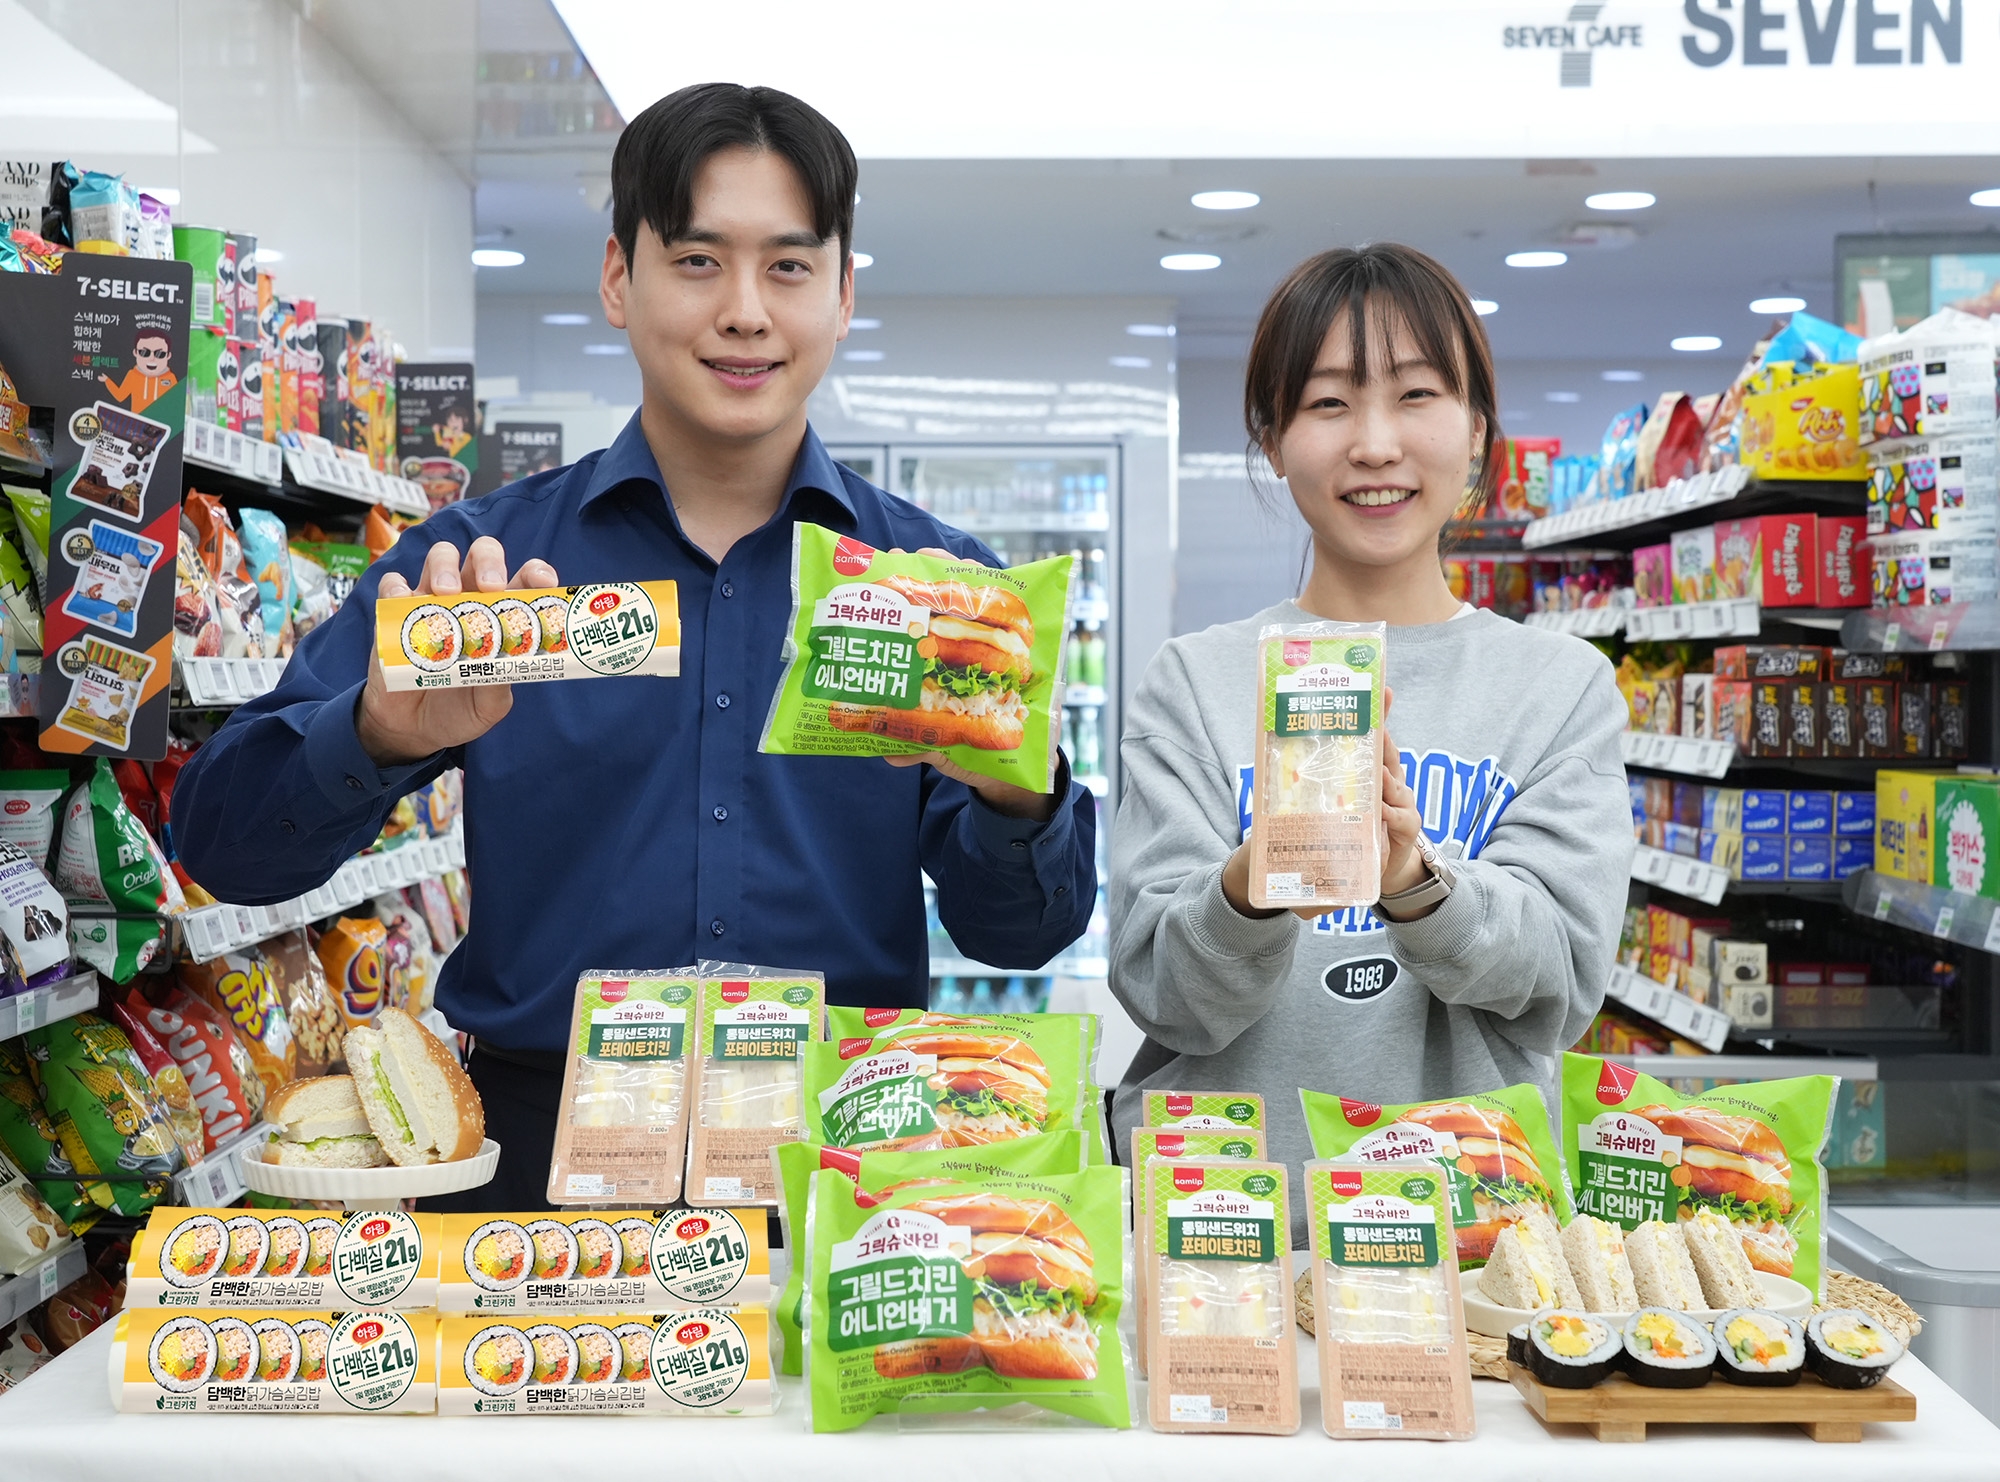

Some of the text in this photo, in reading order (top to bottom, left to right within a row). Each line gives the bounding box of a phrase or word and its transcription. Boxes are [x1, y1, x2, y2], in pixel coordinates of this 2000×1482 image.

[1503, 25, 1642, 48] SEVEN CAFE
[1682, 0, 1963, 67] SEVEN
[4, 174, 39, 188] chips
[77, 276, 179, 303] 7-SELECT
[74, 312, 120, 326] 스낵 MD가
[74, 326, 102, 339] 힙하게
[73, 341, 101, 353] 개발한
[73, 355, 119, 368] 세븐셀렉트
[71, 369, 94, 381] 스낵!
[400, 375, 468, 391] 7-SELECT
[84, 417, 90, 427] 4
[77, 538, 83, 548] 5
[835, 554, 871, 567] samlip
[572, 585, 598, 615] PROTEIN
[594, 595, 616, 611] 하림
[828, 604, 902, 626] 그릭슈바인
[572, 607, 655, 657] 단백질 21g
[72, 651, 78, 661] 6
[818, 635, 913, 669] 그릴드치킨
[424, 677, 452, 687] 그린키친
[814, 662, 908, 698] 어니언버거
[1298, 677, 1350, 688] 그릭슈바인
[819, 703, 843, 712] Chicken
[845, 707, 864, 716] Onion
[866, 710, 888, 718] Burger
[1288, 696, 1358, 711] 통밀샌드위치
[1286, 712, 1358, 731] 포테이토치킨
[1952, 831, 1980, 865] 박카스
[0, 864, 27, 881] HOCOLATE
[1344, 964, 1385, 993] 1983
[601, 990, 627, 998] samlip
[722, 990, 748, 998] samlip
[613, 1011, 664, 1021] 그릭슈바인
[736, 1011, 788, 1021] 그릭슈바인
[866, 1010, 900, 1021] samlip
[602, 1028, 670, 1040] 통밀샌드위치
[726, 1028, 796, 1040] 통밀샌드위치
[598, 1041, 670, 1057] 포테이토치킨
[724, 1040, 796, 1056] 포테이토치킨
[840, 1038, 872, 1055] samlip
[838, 1062, 910, 1095] 그릭슈바인
[1598, 1084, 1628, 1097] samlip
[1346, 1104, 1382, 1118] samlip
[1596, 1131, 1656, 1156] 그릭슈바인
[1175, 1178, 1202, 1186] samlip
[1333, 1182, 1362, 1190] samlip
[1586, 1162, 1667, 1198] 그릴드치킨
[1192, 1203, 1249, 1214] 그릭슈바인
[1352, 1208, 1410, 1220] 그릭슈바인
[343, 1211, 374, 1239] PROTEIN
[364, 1221, 386, 1237] 하림
[658, 1210, 688, 1239] PROTEIN
[680, 1220, 703, 1235] 하림
[1182, 1221, 1260, 1237] 통밀샌드위치
[1343, 1226, 1422, 1242] 통밀샌드위치
[856, 1232, 939, 1258] 그릭슈바인
[1181, 1237, 1262, 1258] 포테이토치킨
[1344, 1244, 1425, 1262] 포테이토치킨
[338, 1236, 418, 1282] 단백질 21g
[656, 1234, 745, 1282] 단백질 21g
[840, 1264, 957, 1307] 그릴드치킨
[166, 1295, 199, 1306] 그린키친
[483, 1297, 516, 1307] 그린키친
[840, 1296, 958, 1337] 어니언버거
[335, 1312, 366, 1342] PROTEIN
[356, 1324, 380, 1340] 하림
[658, 1314, 688, 1344] PROTEIN
[680, 1324, 703, 1340] 하림
[332, 1340, 414, 1388] 단백질 21g
[656, 1340, 745, 1387] 단백질 21g
[164, 1400, 197, 1410] 그린키친
[483, 1402, 516, 1412] 그린키친
